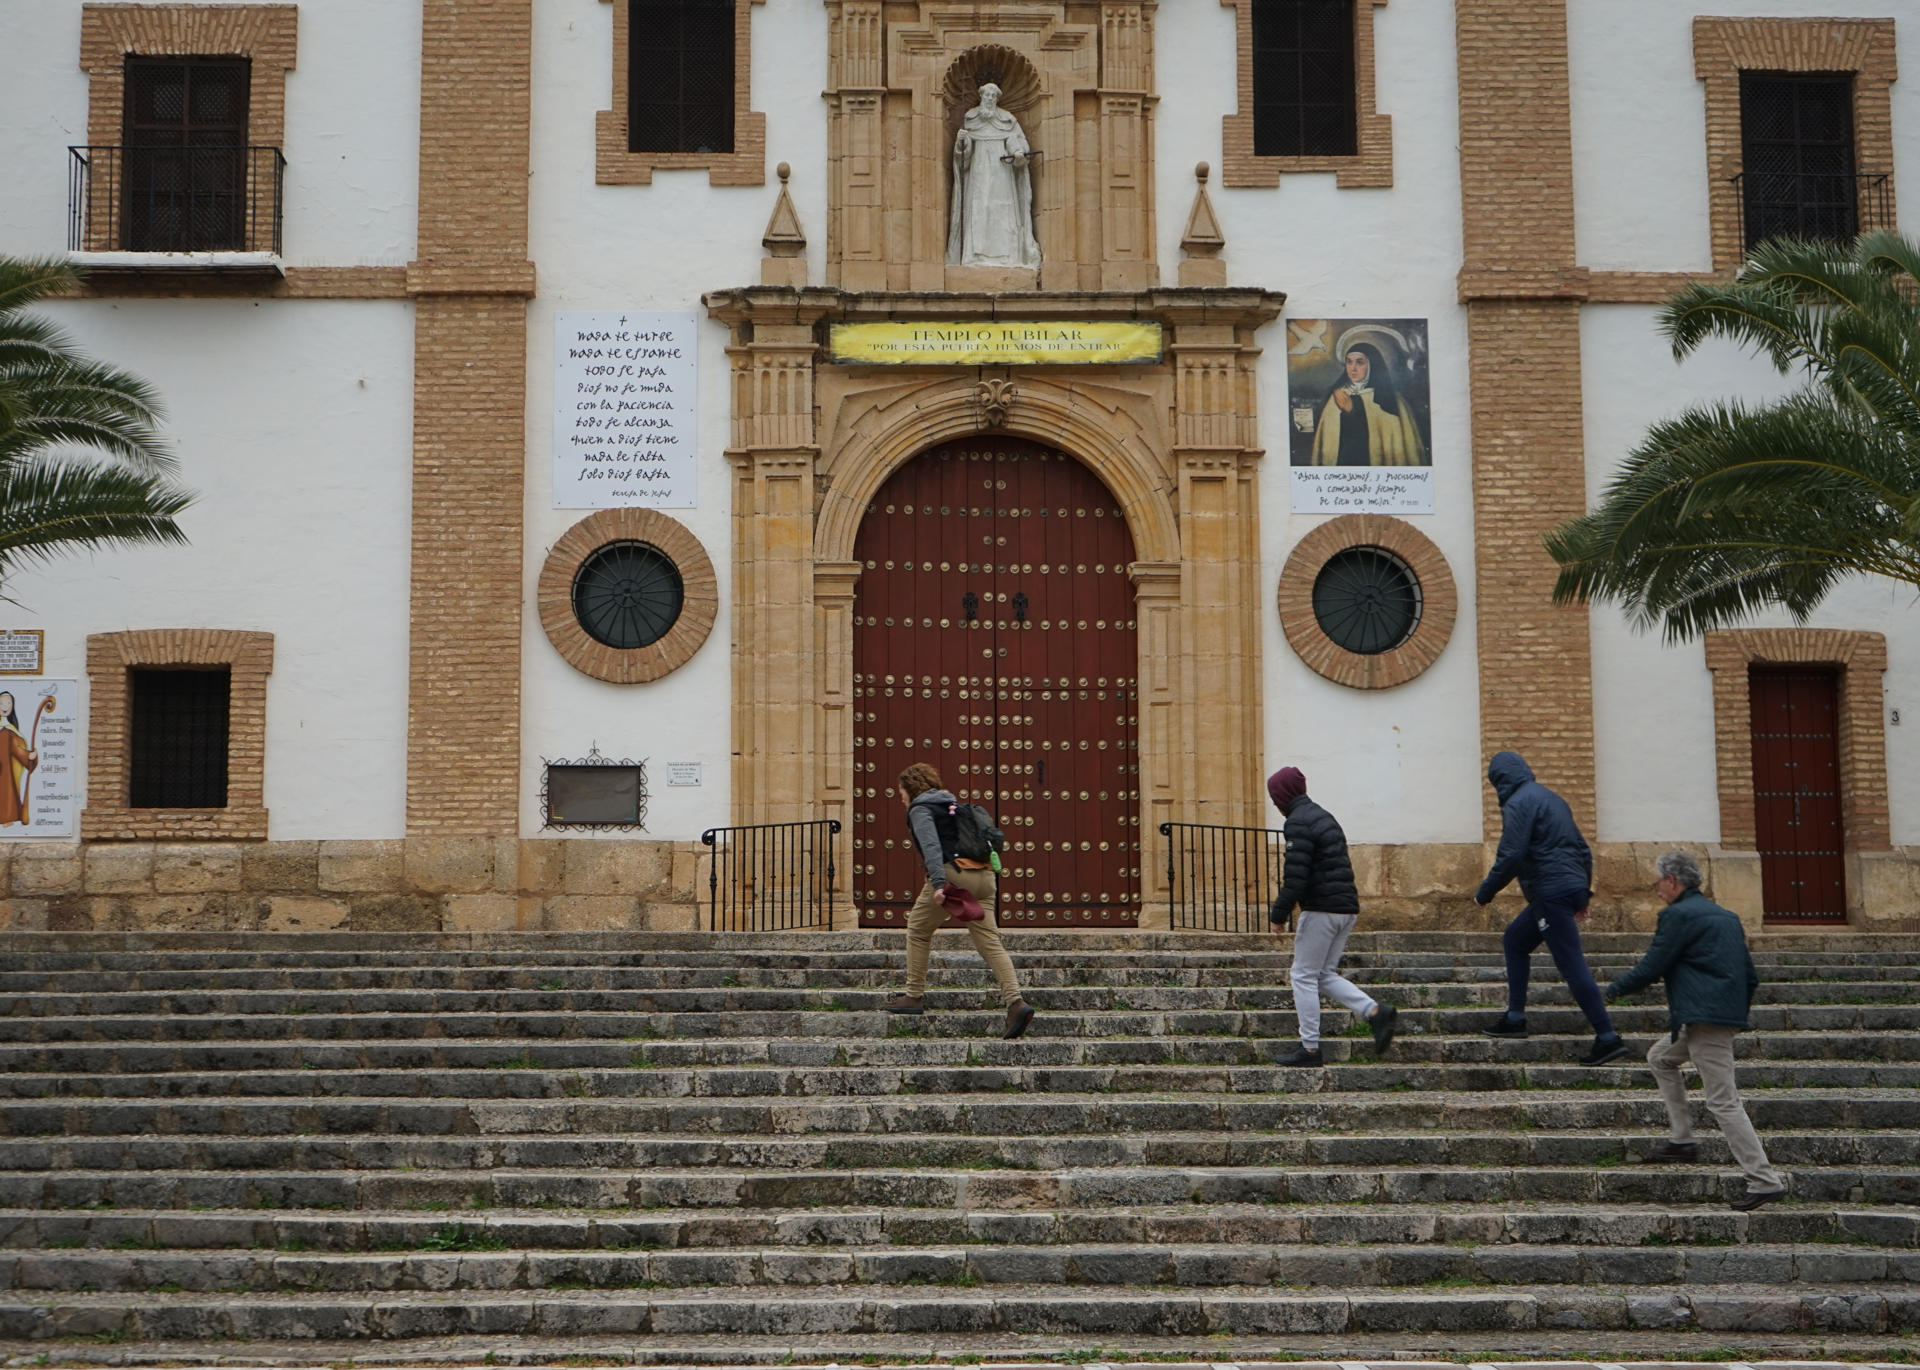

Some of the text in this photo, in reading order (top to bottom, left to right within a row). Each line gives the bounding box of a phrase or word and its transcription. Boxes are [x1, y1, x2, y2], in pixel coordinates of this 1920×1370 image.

[577, 331, 674, 342] nada te turbe
[911, 329, 1083, 341] TEMPLO JUBILAR
[941, 343, 989, 351] PUERTA
[569, 348, 603, 358] nada
[607, 348, 622, 358] te
[584, 365, 615, 376] todo
[637, 365, 667, 378] pasa
[605, 384, 619, 393] no
[640, 382, 673, 393] muda
[576, 399, 674, 413] con la paciencia
[575, 417, 602, 428] todo
[607, 436, 615, 444] a
[645, 434, 679, 444] tiene
[584, 451, 667, 463] nada le falta
[635, 468, 671, 481] basta
[1354, 497, 1363, 506] en
[1892, 710, 1899, 722] 3
